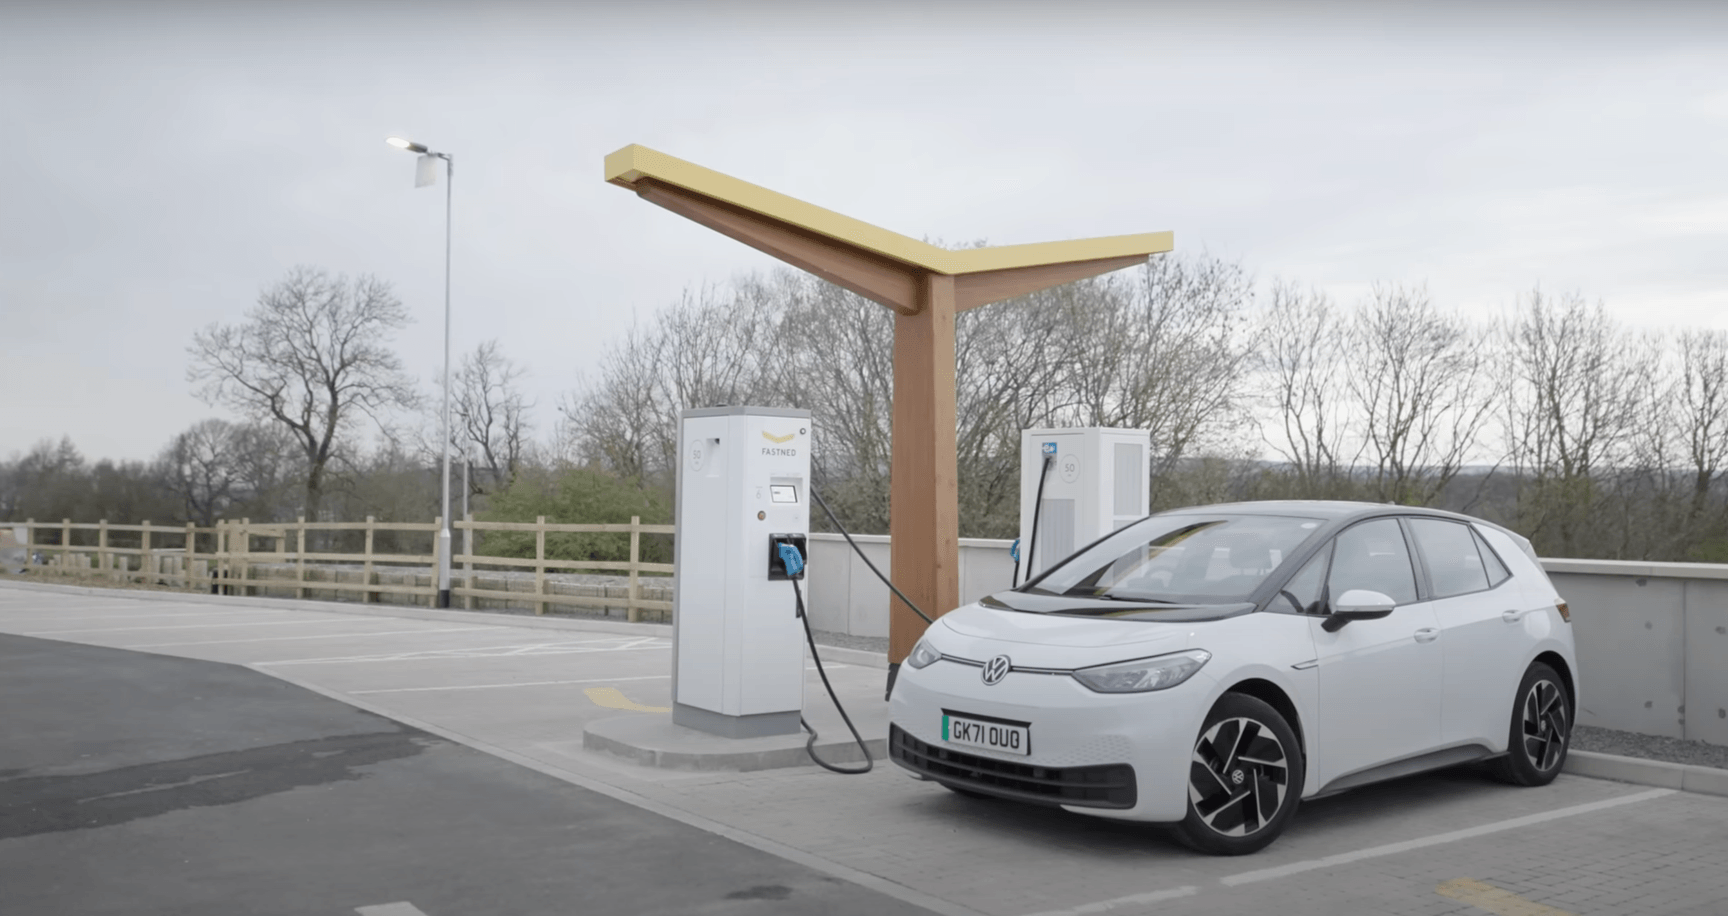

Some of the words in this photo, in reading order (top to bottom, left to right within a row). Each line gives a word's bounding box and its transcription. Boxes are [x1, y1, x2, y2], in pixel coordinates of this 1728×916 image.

[761, 447, 797, 457] FASTNED
[1065, 463, 1075, 473] 50
[953, 720, 985, 744] GK71
